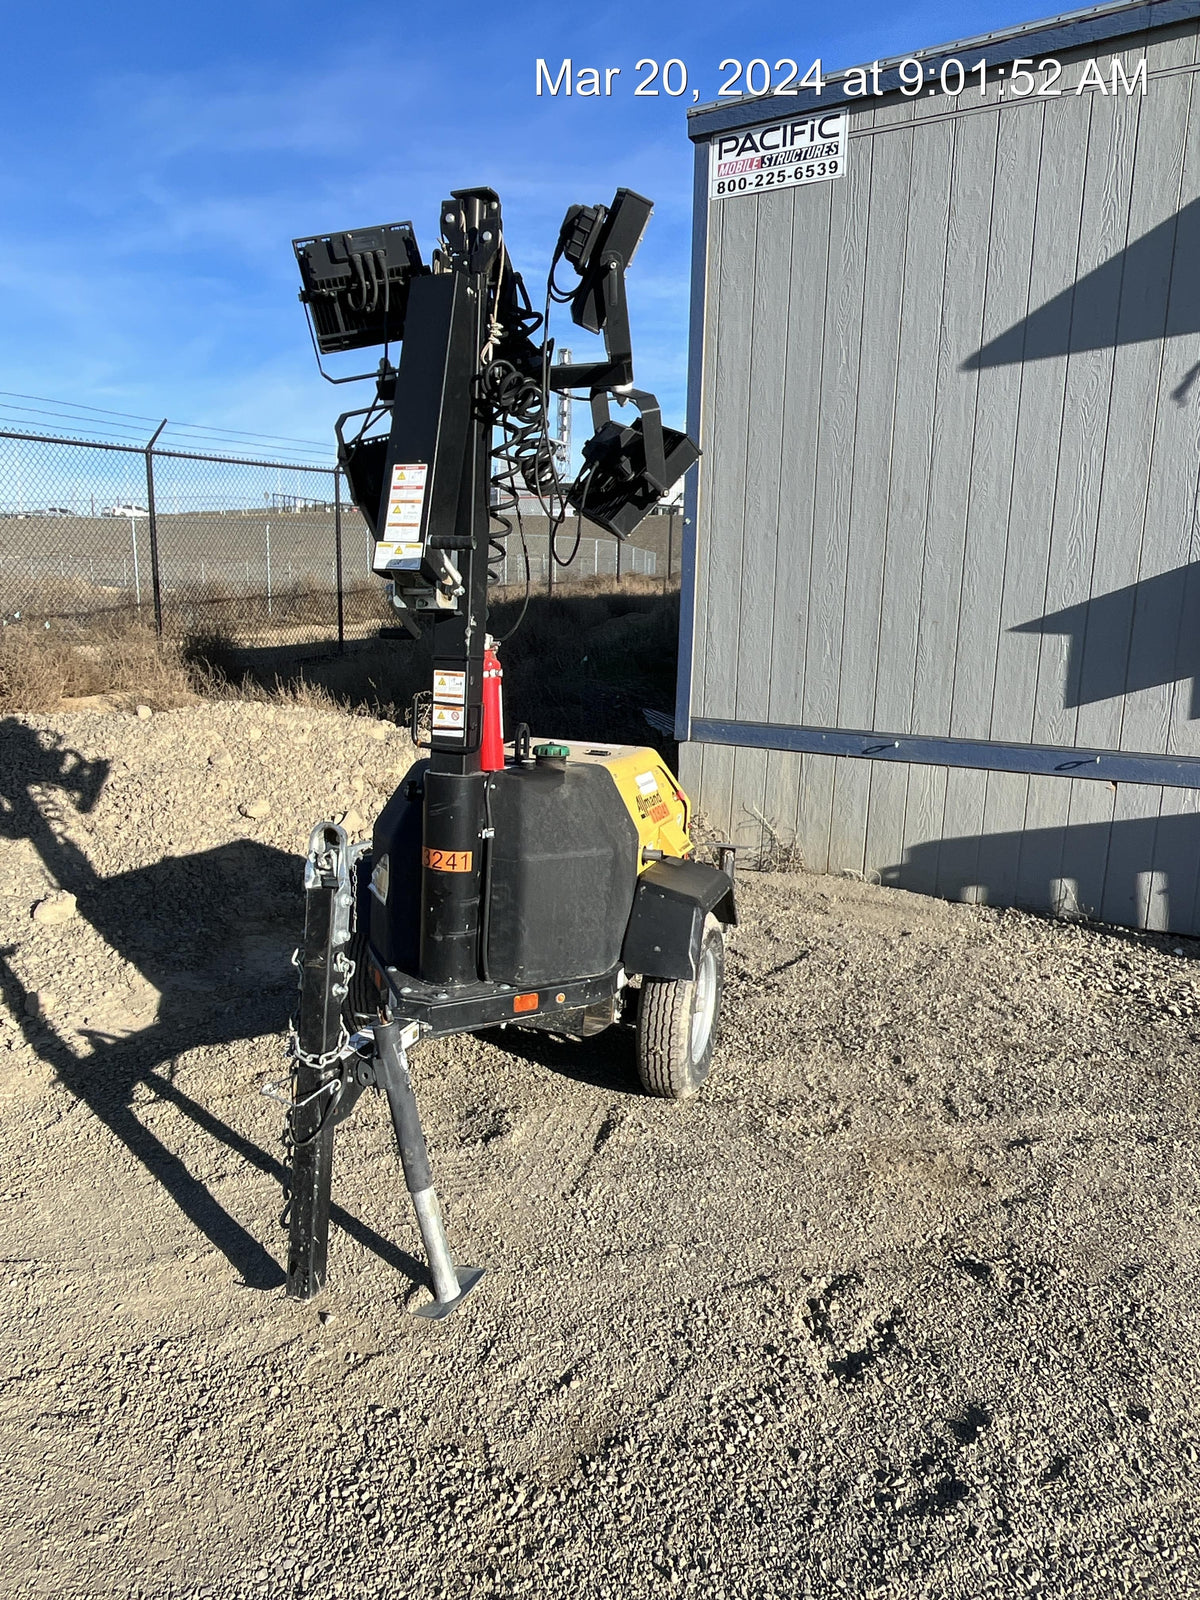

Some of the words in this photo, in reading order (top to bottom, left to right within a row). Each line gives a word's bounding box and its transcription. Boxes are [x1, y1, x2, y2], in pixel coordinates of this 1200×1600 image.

[717, 156, 761, 177] MOBILE
[761, 141, 839, 167] STRUCTURES
[717, 161, 838, 194] 800-225-6539
